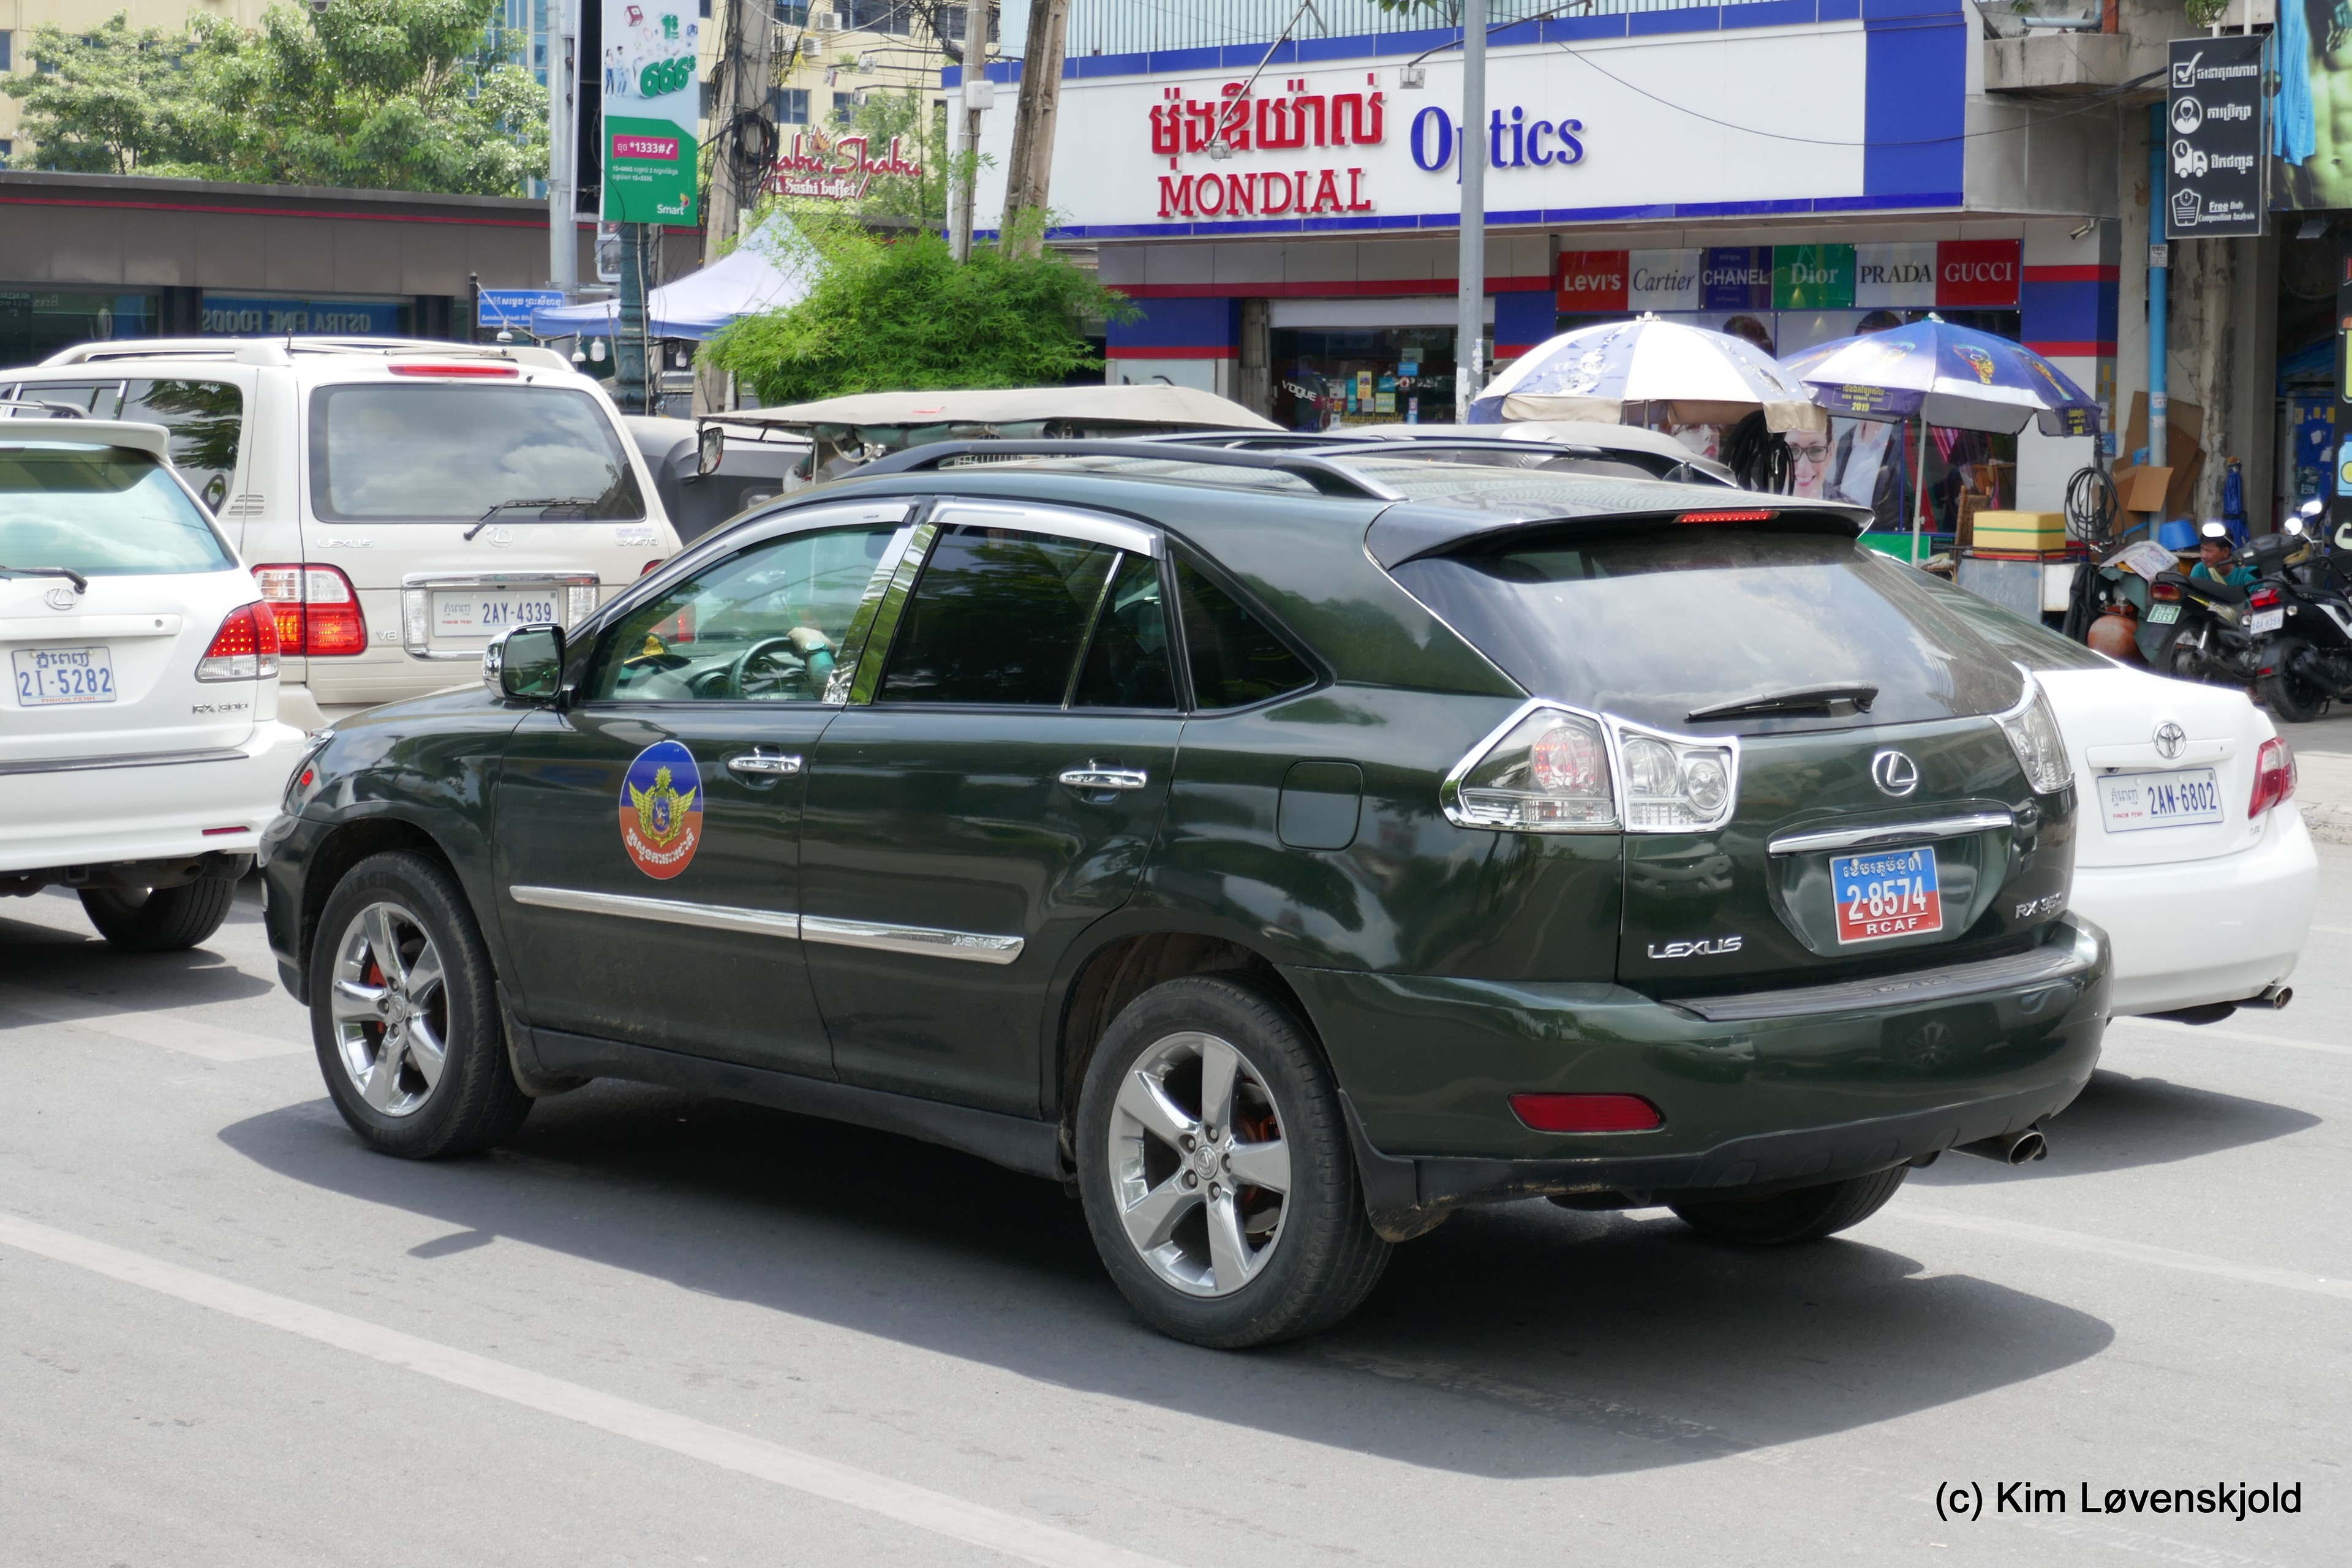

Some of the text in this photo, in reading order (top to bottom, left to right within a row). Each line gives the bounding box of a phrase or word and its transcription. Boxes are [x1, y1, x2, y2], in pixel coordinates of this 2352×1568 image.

[785, 178, 818, 195] Sushi
[820, 179, 856, 199] buffet
[1157, 167, 1373, 217] MONDIAL
[657, 204, 684, 215] Smart
[2209, 200, 2244, 211] Free Body
[2198, 211, 2255, 224] Composition Analysis
[1634, 268, 1695, 292] Cartier
[1702, 269, 1768, 285] CHANEL
[1790, 263, 1838, 284] Dior
[1860, 264, 1933, 283] PRADA
[1945, 263, 2012, 282] GUCCI
[1852, 402, 1870, 412] 2019
[317, 538, 373, 548] LEXUS
[483, 602, 552, 624] 2AY-4339
[2148, 782, 2217, 815] 2AN-6802
[1847, 876, 1926, 921] 2-8574
[2015, 900, 2038, 919] RX
[1866, 918, 1918, 935] RCAF
[1647, 937, 1742, 959] LEXUS
